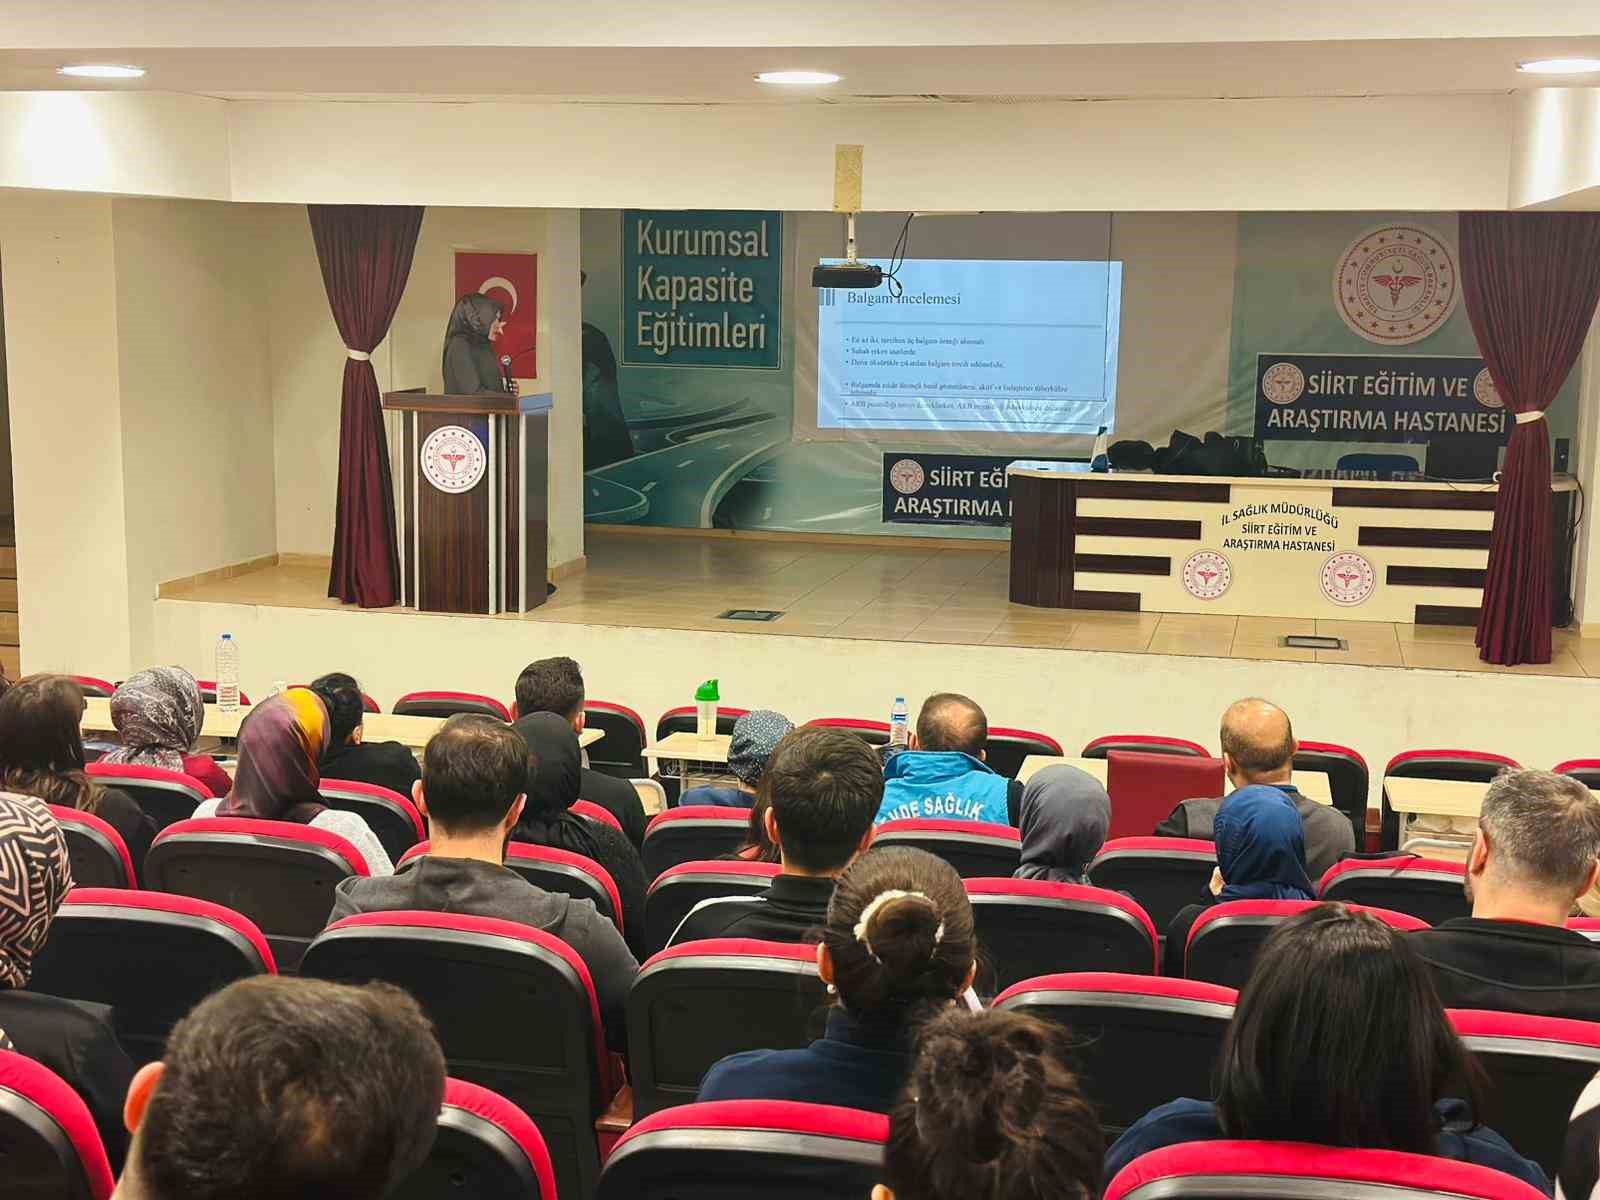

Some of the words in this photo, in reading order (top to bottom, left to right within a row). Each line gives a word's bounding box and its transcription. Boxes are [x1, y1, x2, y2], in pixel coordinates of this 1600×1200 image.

[637, 219, 769, 257] Kurumsal
[637, 265, 754, 310] Kapasite
[847, 291, 894, 307] Balgam
[637, 310, 766, 356] Eğitimleri
[1308, 370, 1359, 395] SİİRT
[1363, 371, 1436, 397] EĞİTİM
[1442, 377, 1468, 398] VE
[1267, 408, 1388, 433] ARAŞTIRMA
[1392, 408, 1507, 434] HASTANESİ
[929, 466, 975, 488] SİİRT
[980, 466, 1009, 489] EĞİ
[894, 497, 1003, 518] ARAŞTIRMA
[1232, 503, 1269, 521] SAĞLIK
[1270, 501, 1339, 530] MÜDÜRLÜĞÜ
[1242, 523, 1266, 535] SİİRT
[1267, 523, 1302, 536] EĞİTİM
[1304, 526, 1317, 536] VE
[1223, 539, 1280, 552] ARAŞTIRMA
[1282, 540, 1335, 553] HASTANESİ
[924, 792, 985, 821] SAĞLIK
